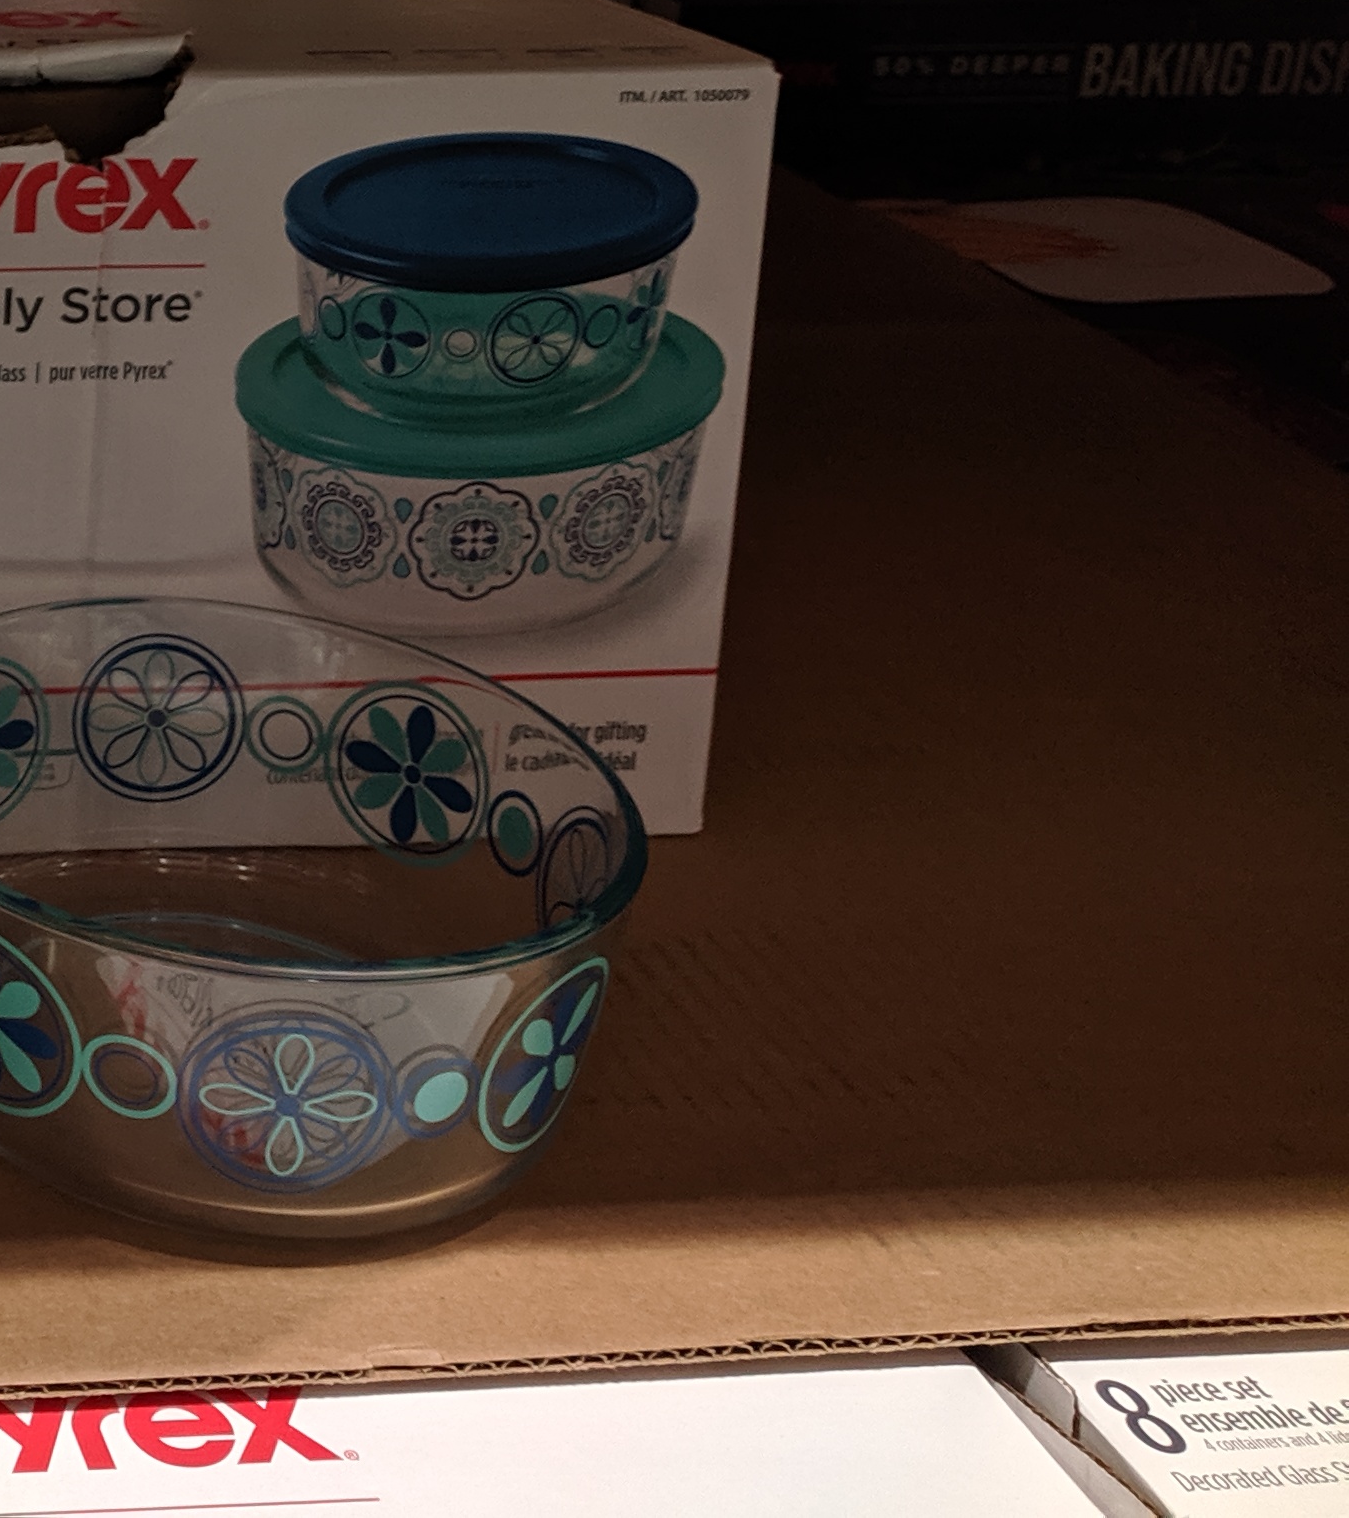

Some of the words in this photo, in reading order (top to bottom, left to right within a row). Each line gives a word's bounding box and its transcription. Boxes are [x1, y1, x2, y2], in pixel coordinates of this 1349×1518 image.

[1077, 40, 1253, 99] BAKING
[1149, 1378, 1222, 1408] piece
[1223, 1375, 1273, 1402] set
[1094, 1379, 1187, 1455] 8
[1169, 1465, 1286, 1493] Decorated
[1277, 1463, 1339, 1486] Glass
